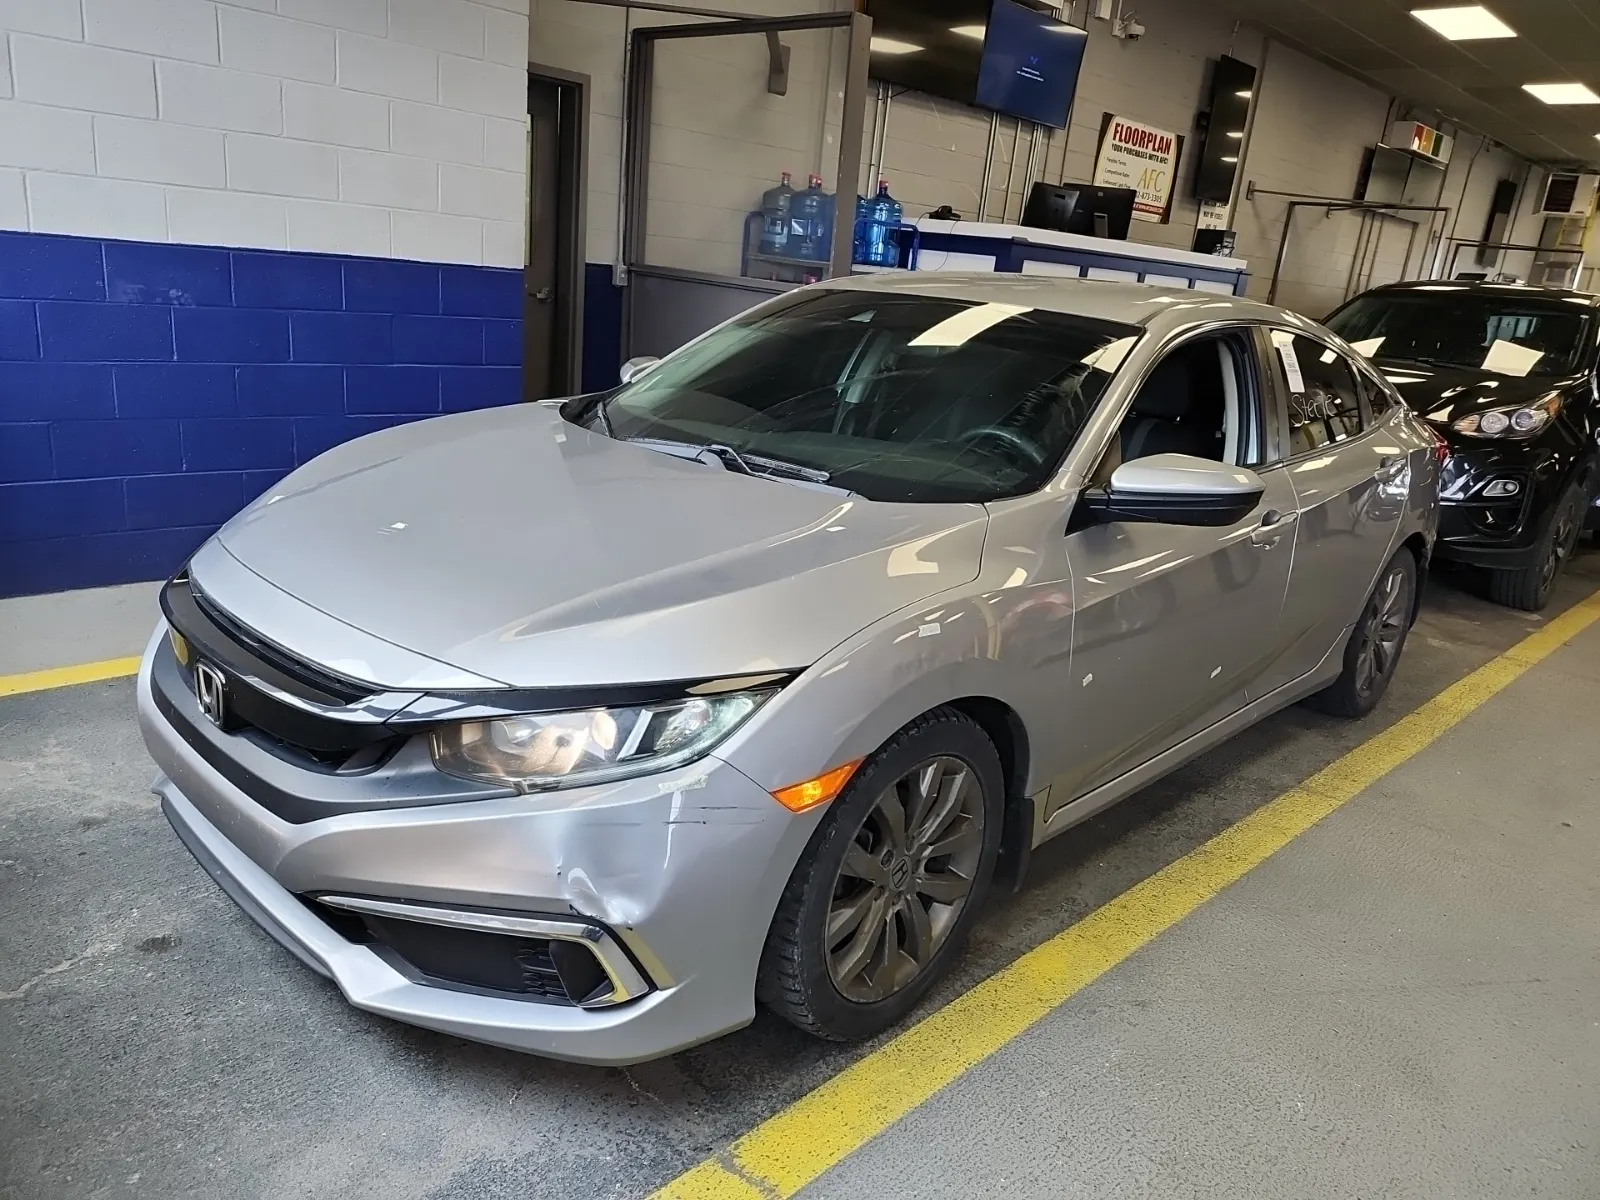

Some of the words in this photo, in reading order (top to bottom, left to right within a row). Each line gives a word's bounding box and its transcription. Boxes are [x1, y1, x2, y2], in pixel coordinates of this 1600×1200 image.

[1112, 143, 1122, 153] YOUR
[1122, 146, 1148, 160] PURCHASES
[1113, 123, 1172, 155] FLOORPLAN
[1137, 166, 1165, 193] AFC
